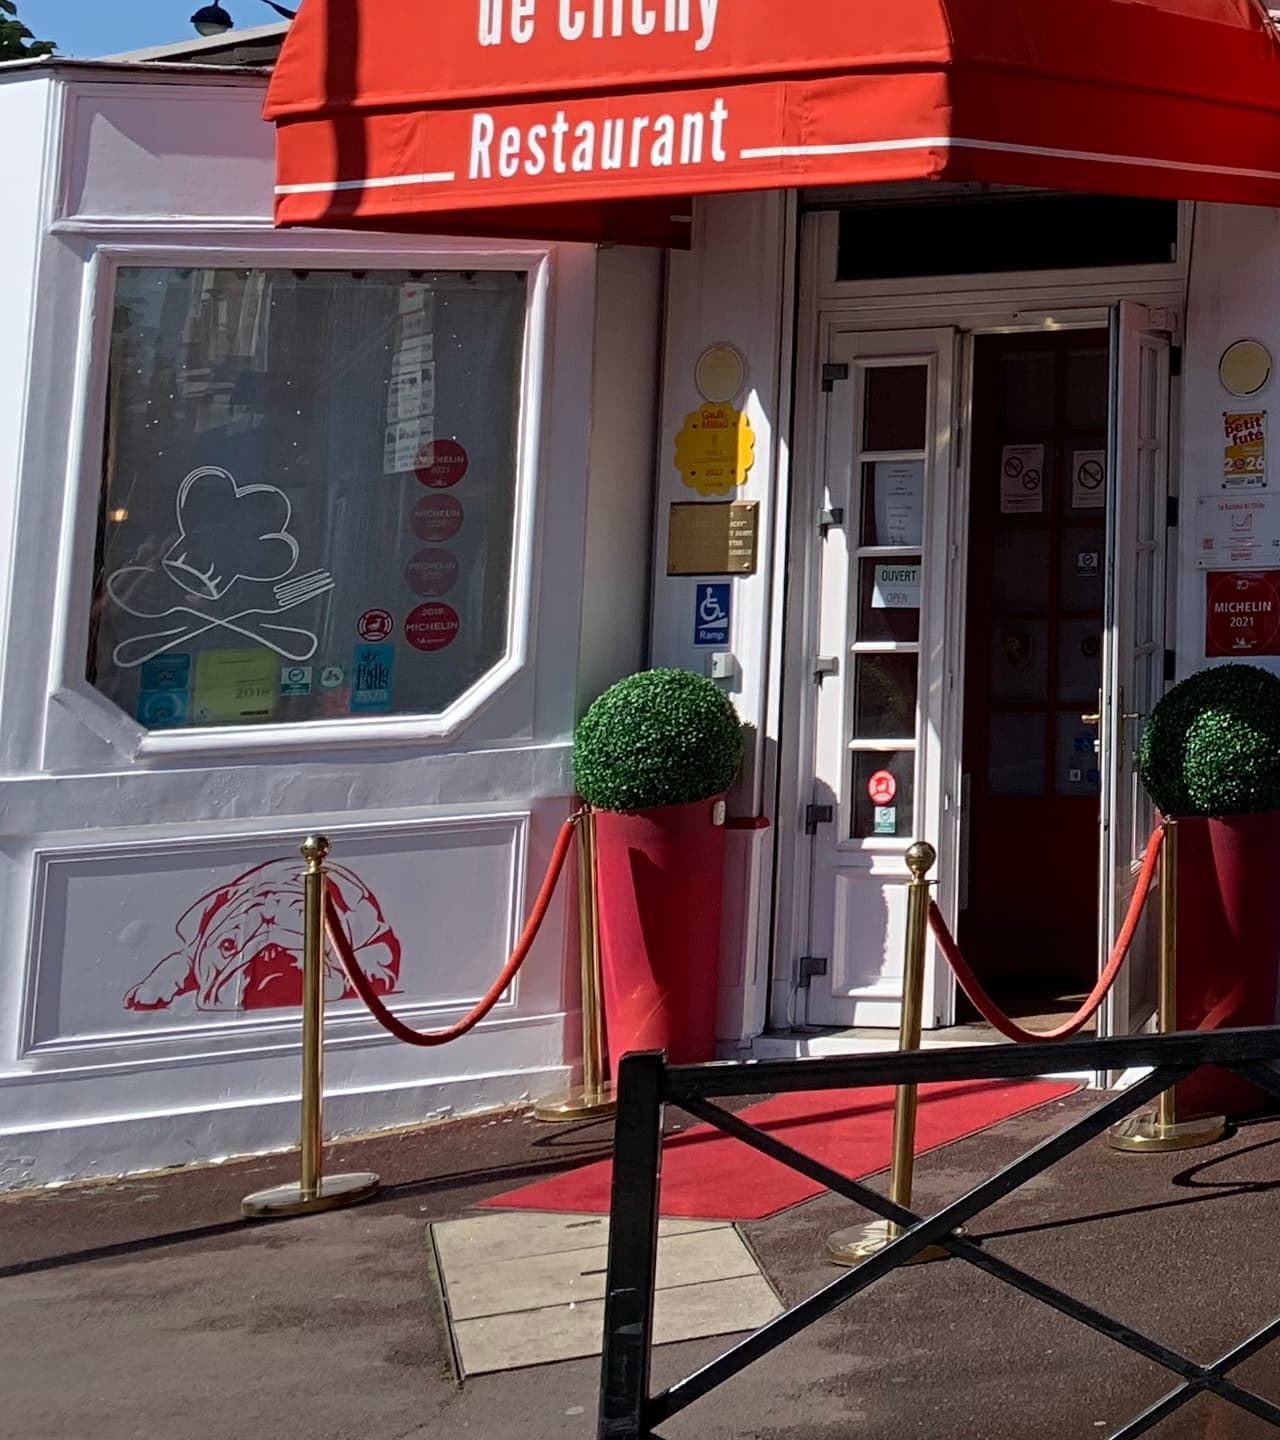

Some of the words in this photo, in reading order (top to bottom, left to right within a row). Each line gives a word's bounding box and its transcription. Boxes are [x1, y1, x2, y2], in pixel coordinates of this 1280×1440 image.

[468, 97, 728, 180] Restaurant
[1225, 416, 1262, 438] petit
[881, 570, 917, 582] OUVERT
[887, 592, 908, 604] OPEN
[1214, 601, 1272, 613] MICHELIN
[406, 621, 458, 633] MICHELIN
[1230, 616, 1254, 628] 2021
[700, 630, 725, 641] Ramp
